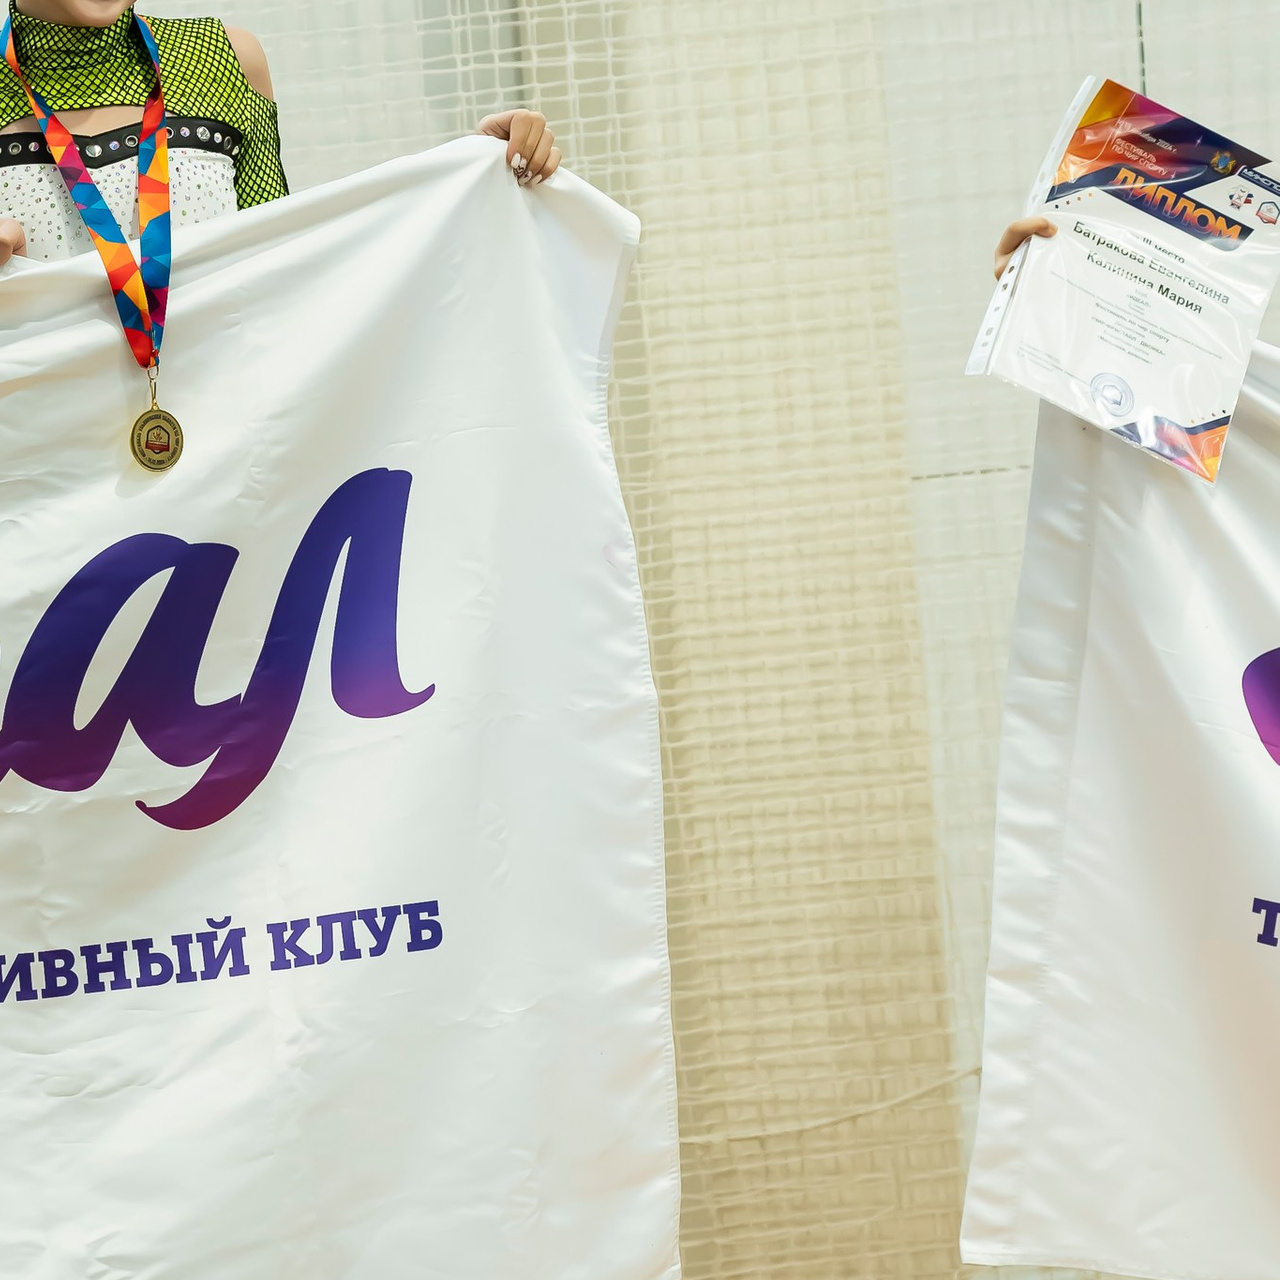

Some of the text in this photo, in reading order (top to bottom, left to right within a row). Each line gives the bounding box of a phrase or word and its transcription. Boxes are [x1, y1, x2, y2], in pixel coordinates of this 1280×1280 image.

[1112, 145, 1168, 176] ПО ЧИР СПОРТУ
[1115, 139, 1157, 163] ФЕСТИВАЛЬ
[1109, 167, 1242, 241] ДИПЛОМ
[1073, 221, 1145, 265] Батракова
[1157, 284, 1203, 314] Мария
[268, 899, 446, 974] КЛУБ
